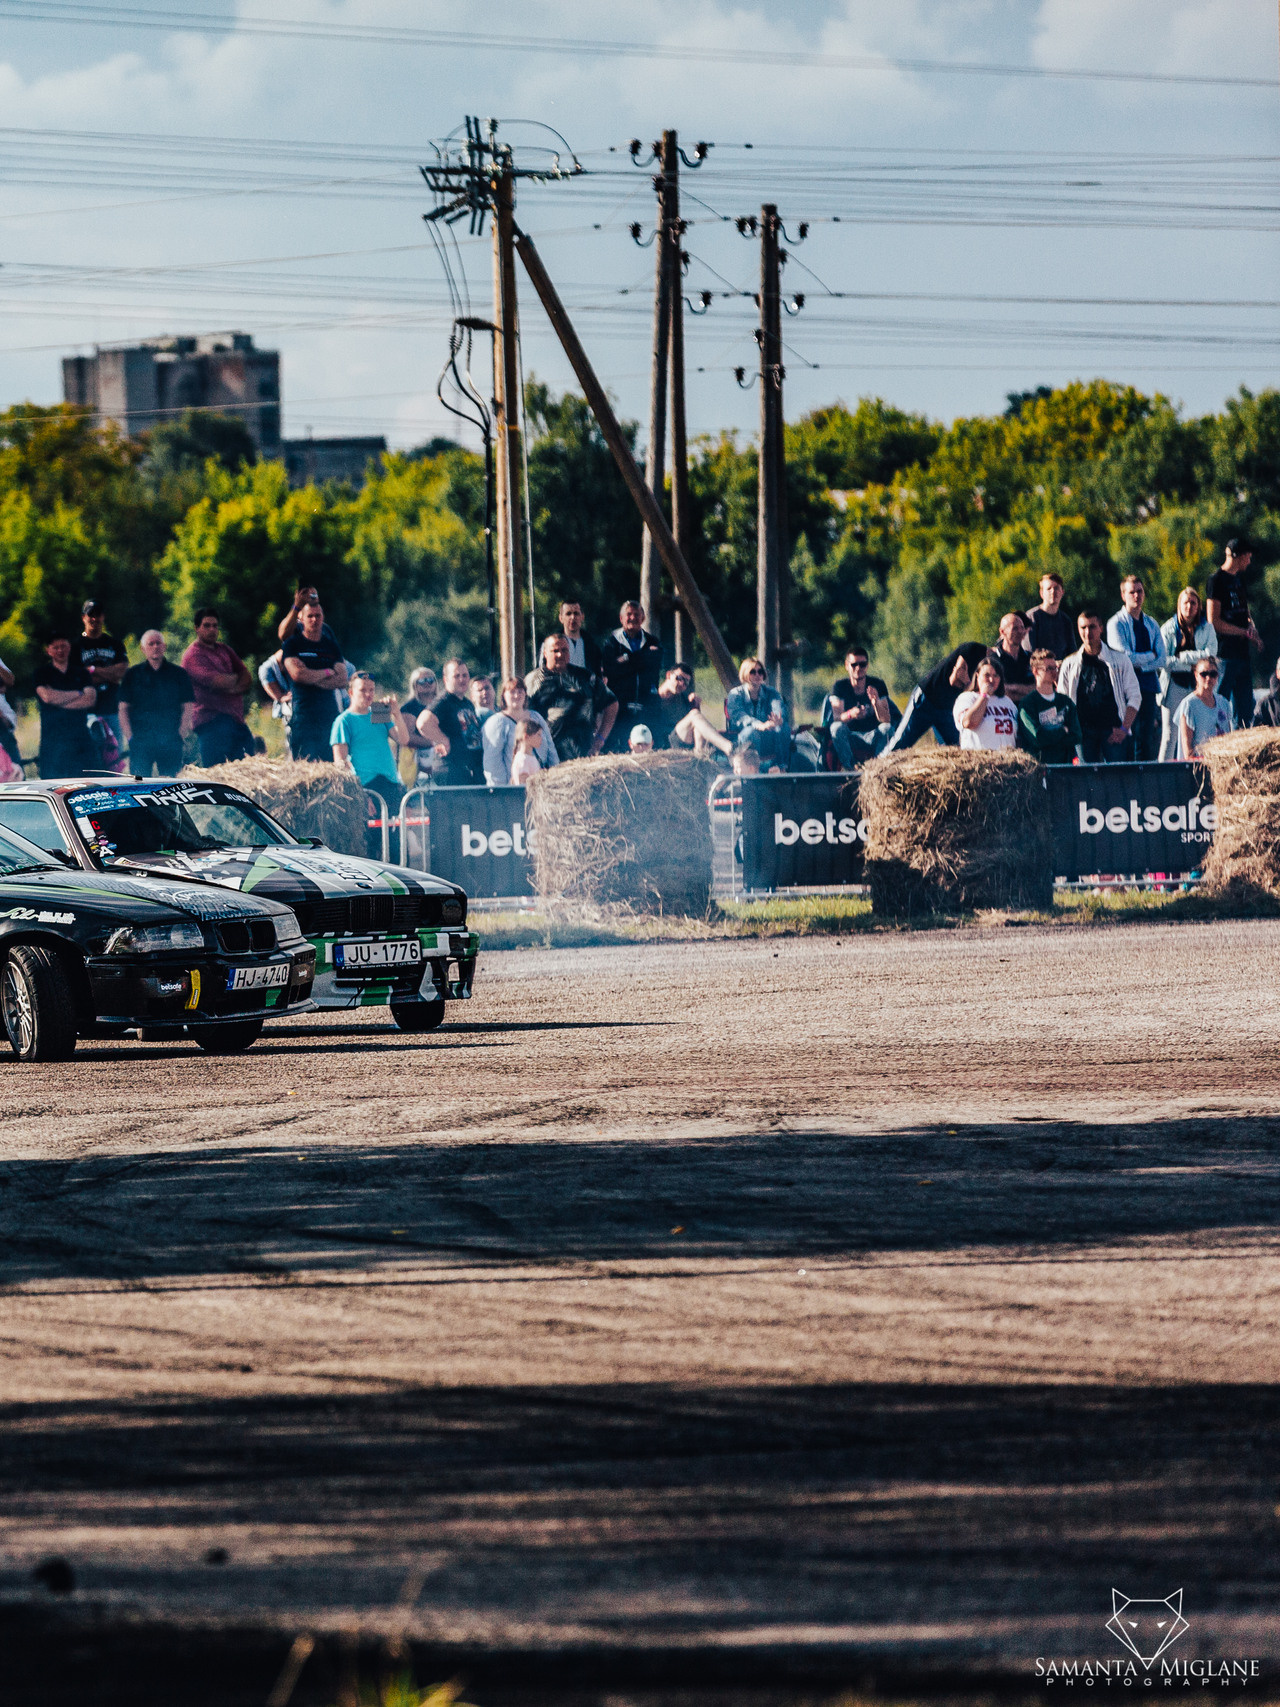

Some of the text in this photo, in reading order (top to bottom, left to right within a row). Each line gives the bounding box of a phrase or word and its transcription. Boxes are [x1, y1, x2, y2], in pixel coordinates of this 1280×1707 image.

[995, 718, 1014, 734] 23
[1079, 797, 1220, 834] betsafe
[1181, 832, 1216, 843] SPORT
[348, 942, 419, 963] JU-1776
[236, 965, 288, 988] HJ-4740
